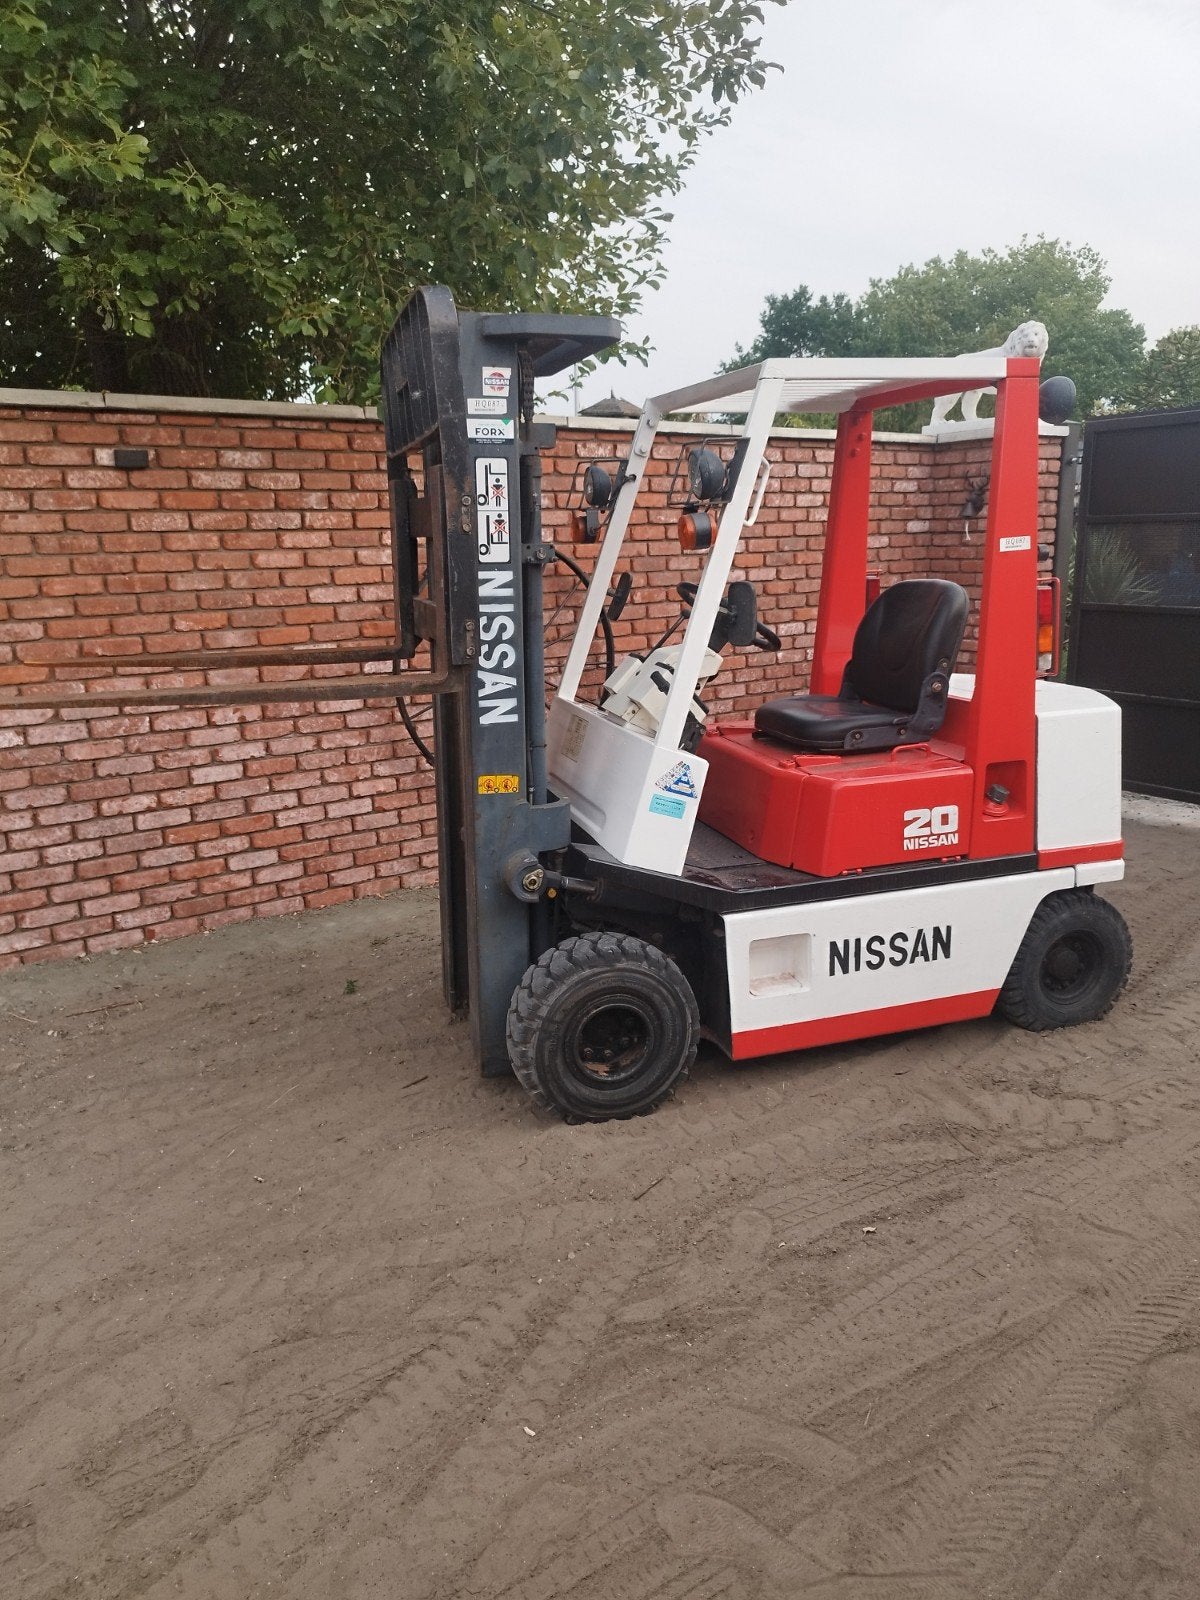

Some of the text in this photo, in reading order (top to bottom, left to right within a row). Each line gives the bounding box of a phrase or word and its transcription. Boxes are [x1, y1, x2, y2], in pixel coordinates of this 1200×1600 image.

[475, 427, 505, 436] FORX
[478, 571, 519, 725] NISSAN
[904, 805, 959, 838] 20
[904, 833, 959, 851] NISSAN
[829, 925, 952, 977] NISSAN
